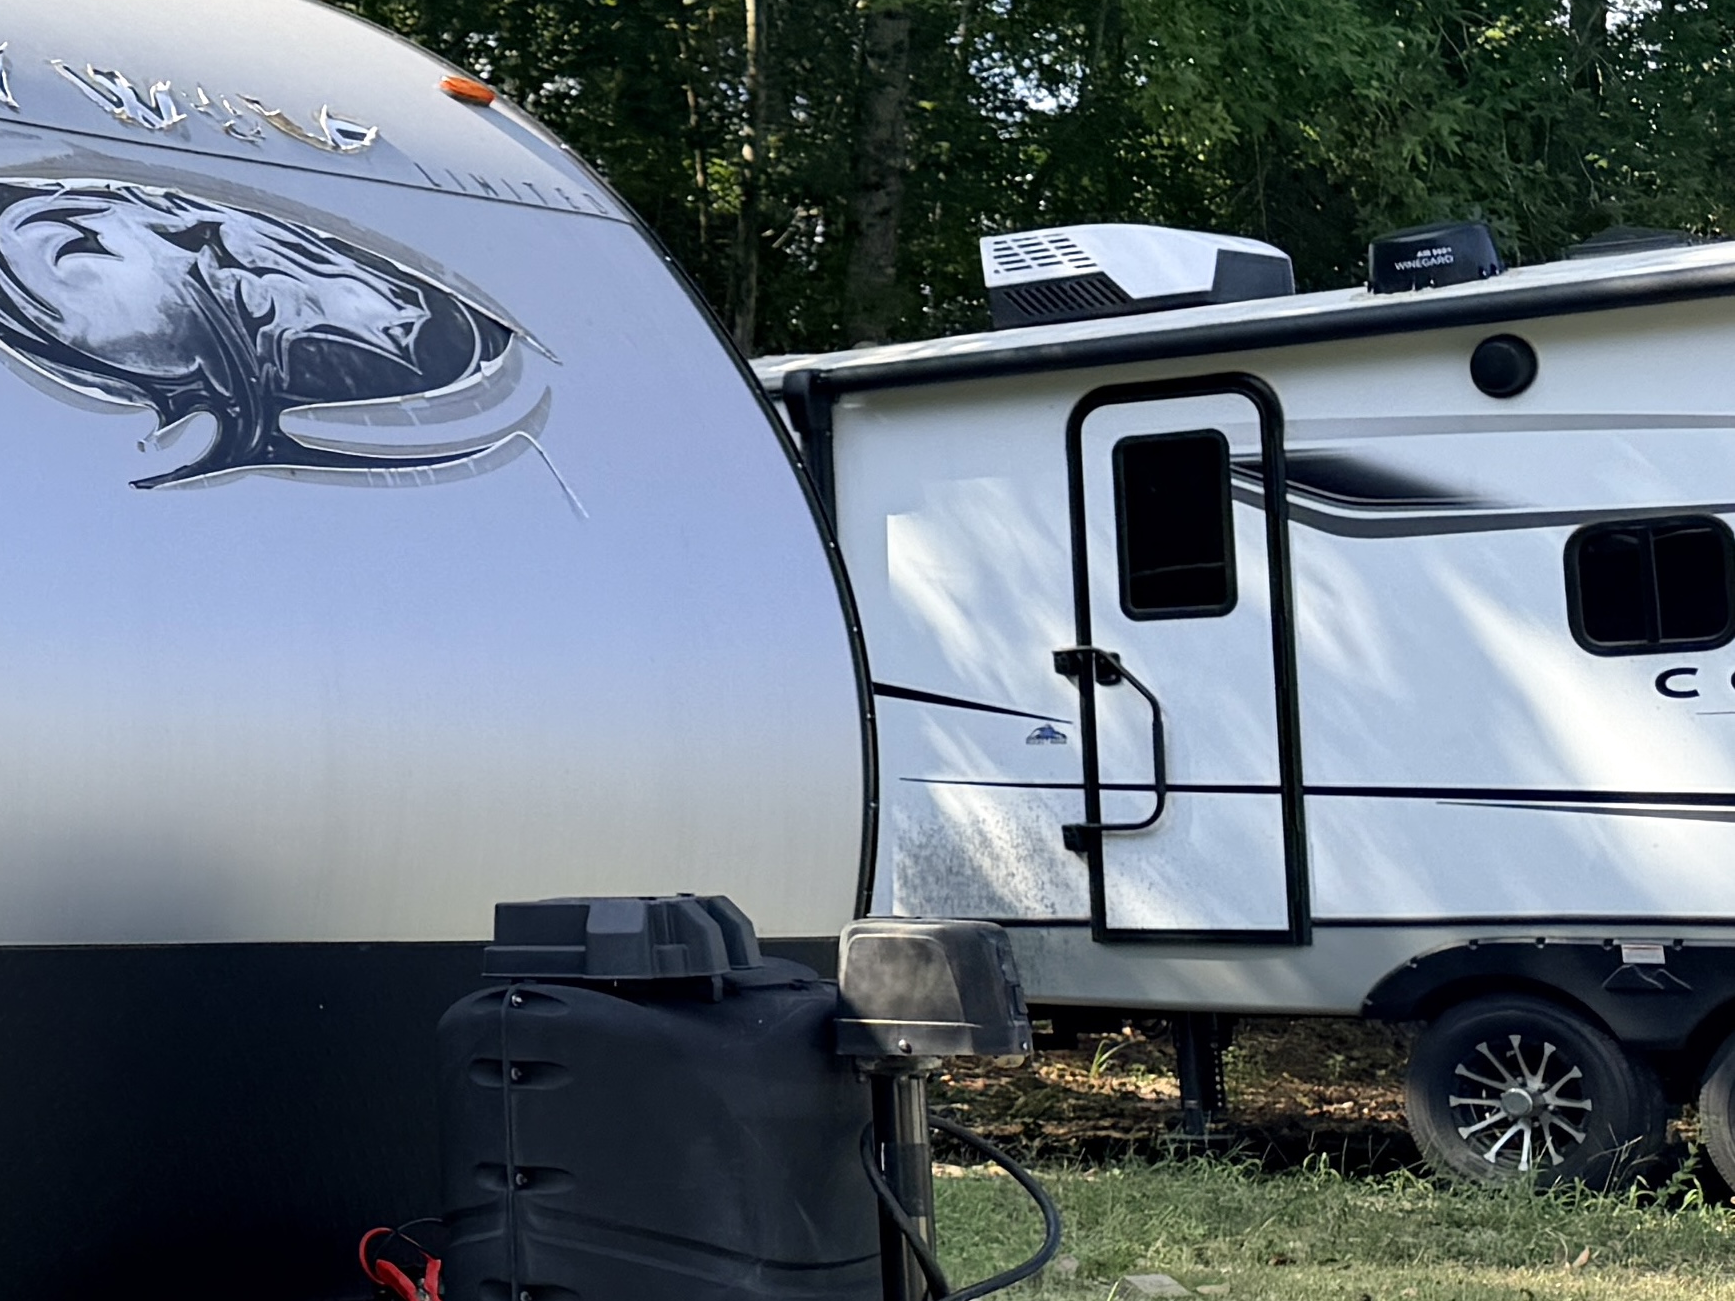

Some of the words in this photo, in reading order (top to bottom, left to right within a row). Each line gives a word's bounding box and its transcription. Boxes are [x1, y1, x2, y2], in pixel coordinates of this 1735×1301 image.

[412, 162, 609, 215] LIMITED
[1394, 254, 1455, 271] WINEGARD
[1655, 667, 1735, 699] C
